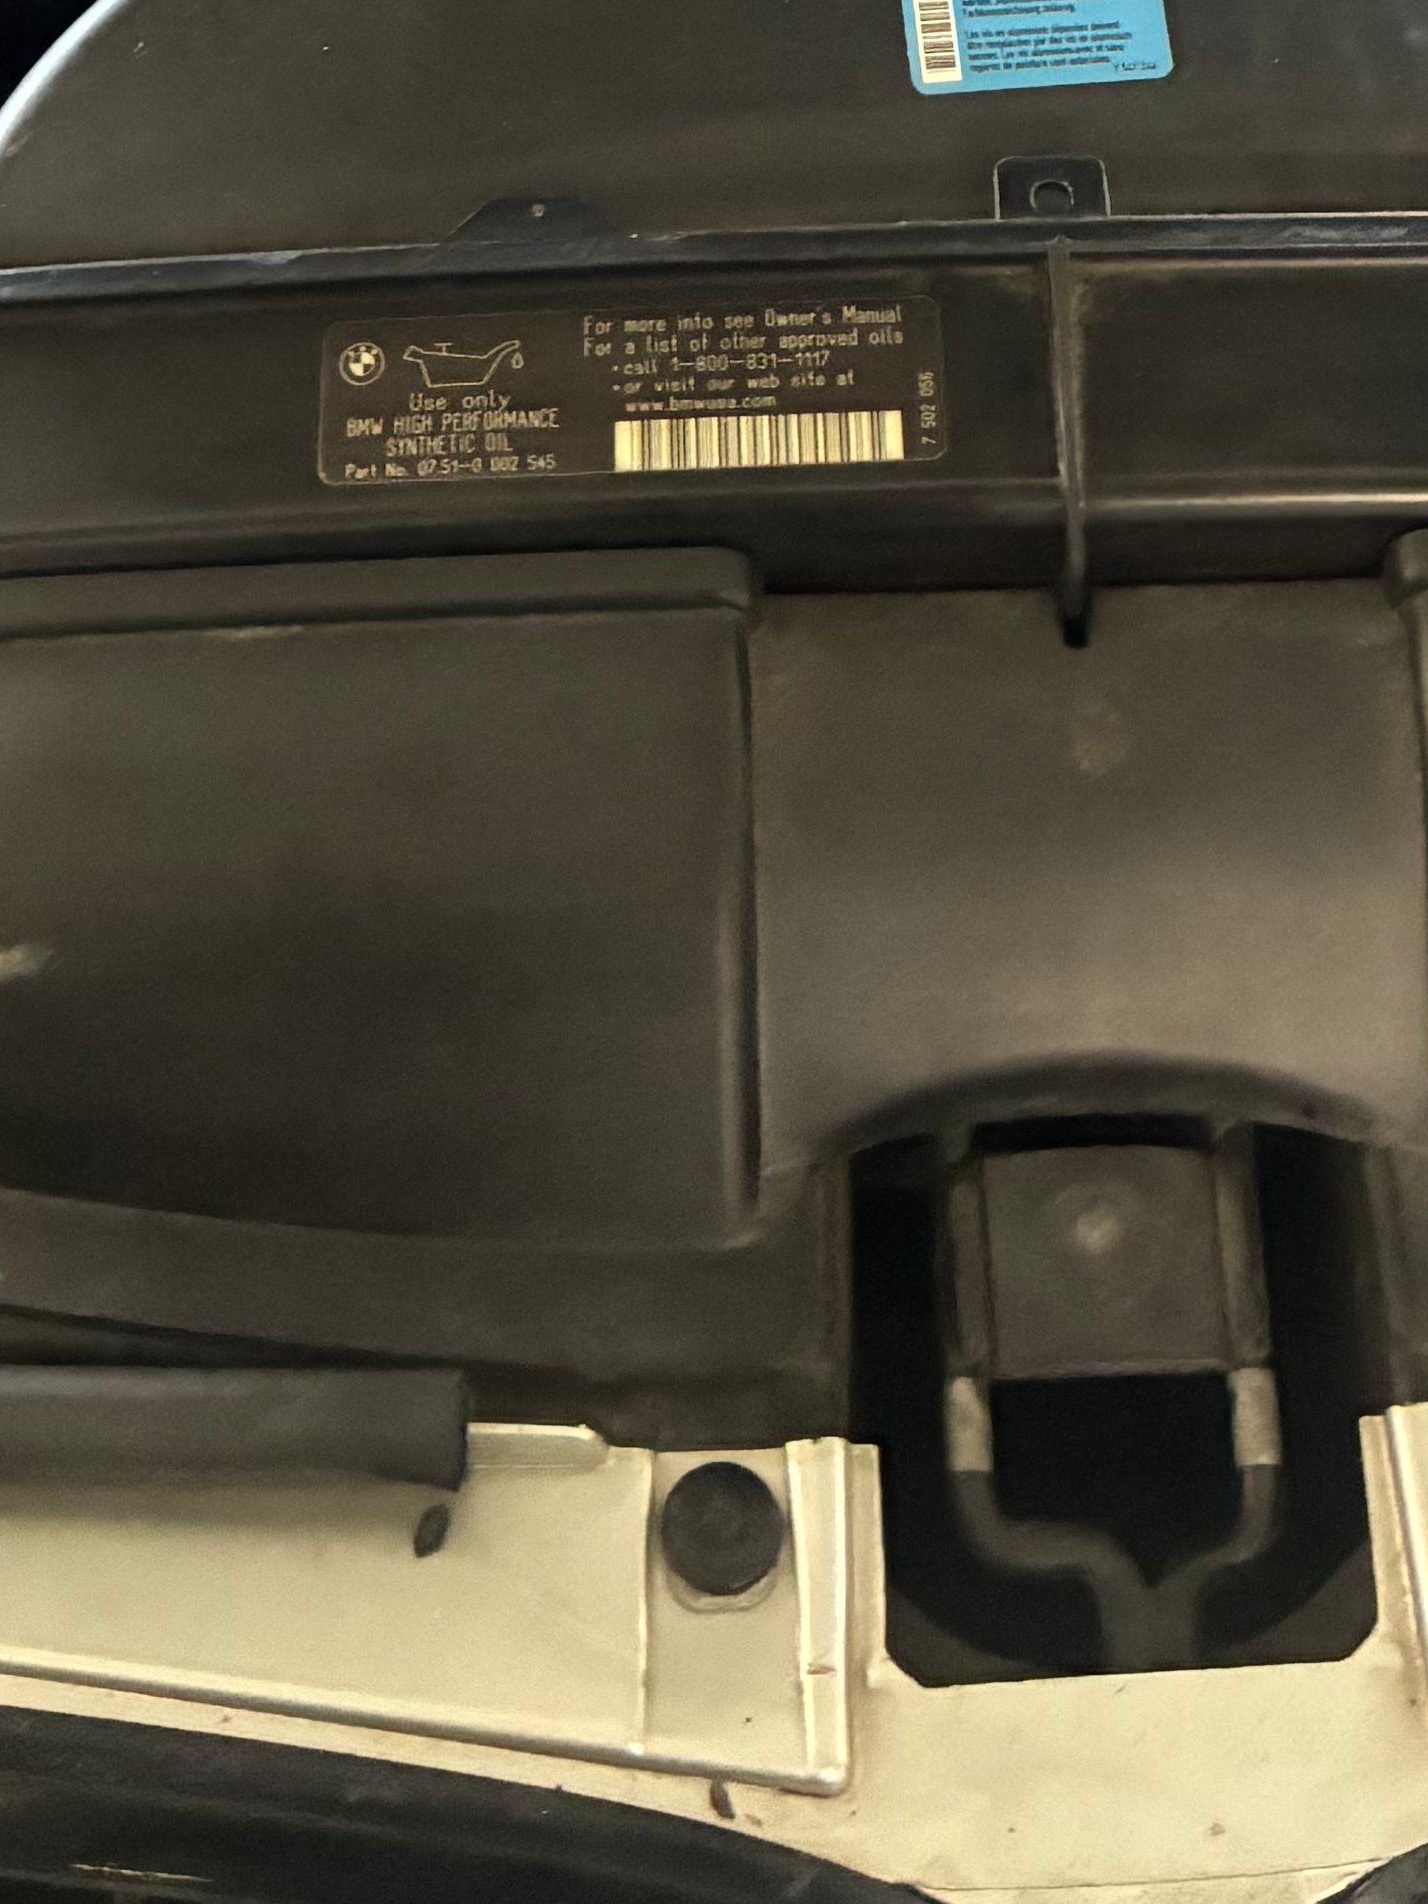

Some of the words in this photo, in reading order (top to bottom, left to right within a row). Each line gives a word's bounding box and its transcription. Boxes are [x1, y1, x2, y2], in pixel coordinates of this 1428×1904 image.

[582, 314, 614, 336] For
[623, 318, 668, 334] more
[676, 310, 715, 332] info
[723, 314, 756, 330] see
[841, 303, 903, 325] Manual
[582, 336, 613, 358] For
[624, 341, 637, 356] a
[645, 333, 679, 354] list
[689, 331, 709, 353] of
[719, 330, 767, 351] other
[778, 326, 859, 351] approved
[868, 324, 905, 346] oils
[653, 374, 696, 393] visit
[746, 372, 781, 390] web
[789, 369, 827, 388] site
[835, 367, 856, 387] at
[408, 391, 448, 412] Use
[461, 388, 512, 414] only
[345, 415, 384, 439] BMW
[392, 413, 434, 435] HIGH
[440, 406, 560, 433] PERFORMANCE
[384, 433, 477, 458] SYNTHETIC
[483, 431, 515, 453] OIL
[344, 462, 378, 481] Part
